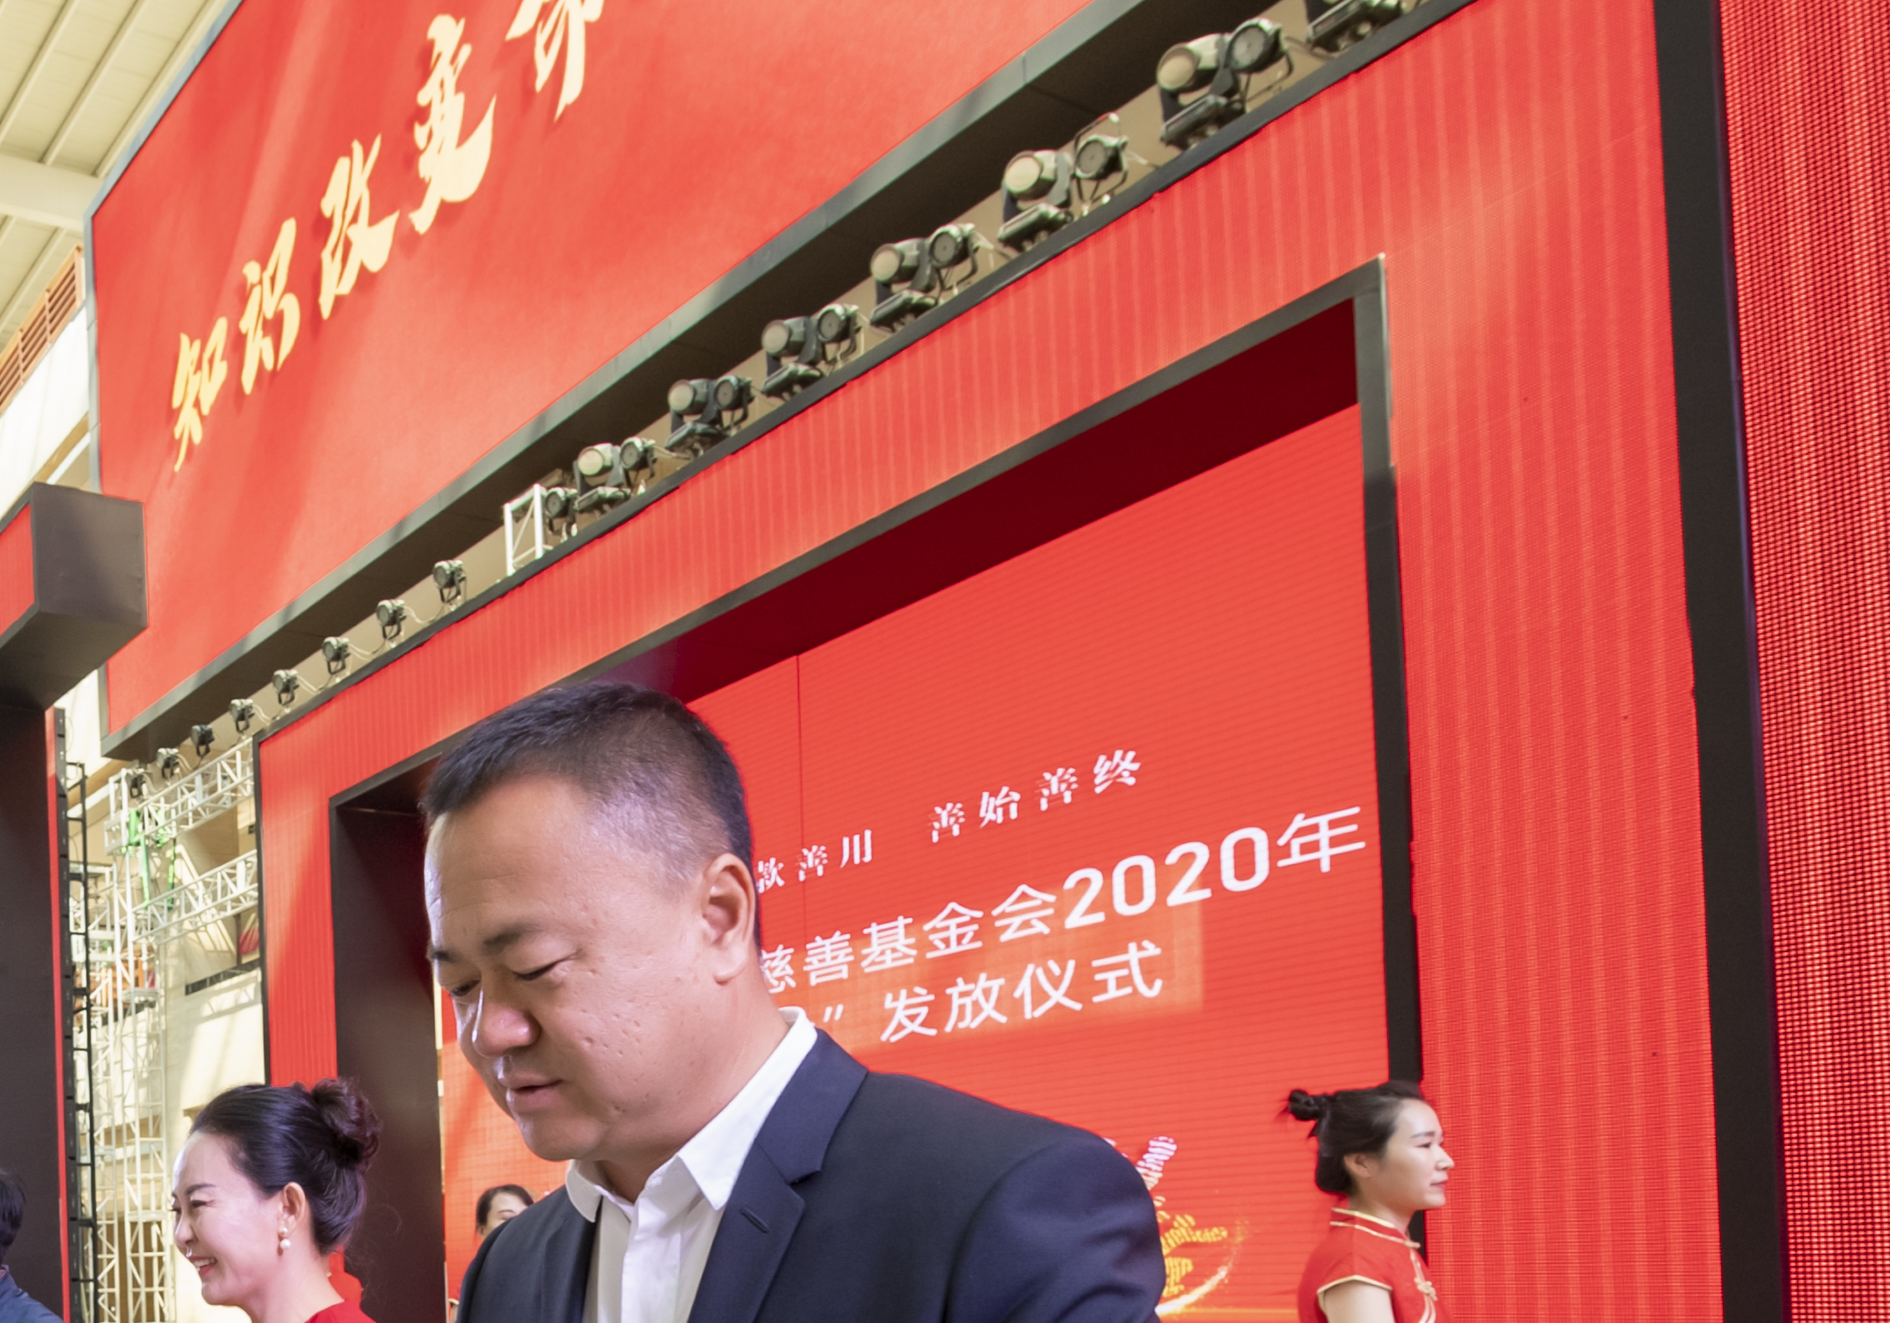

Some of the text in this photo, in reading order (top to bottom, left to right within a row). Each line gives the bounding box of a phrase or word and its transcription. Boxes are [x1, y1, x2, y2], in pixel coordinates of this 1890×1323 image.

[759, 805, 1366, 994] 慈善基金会2020年
